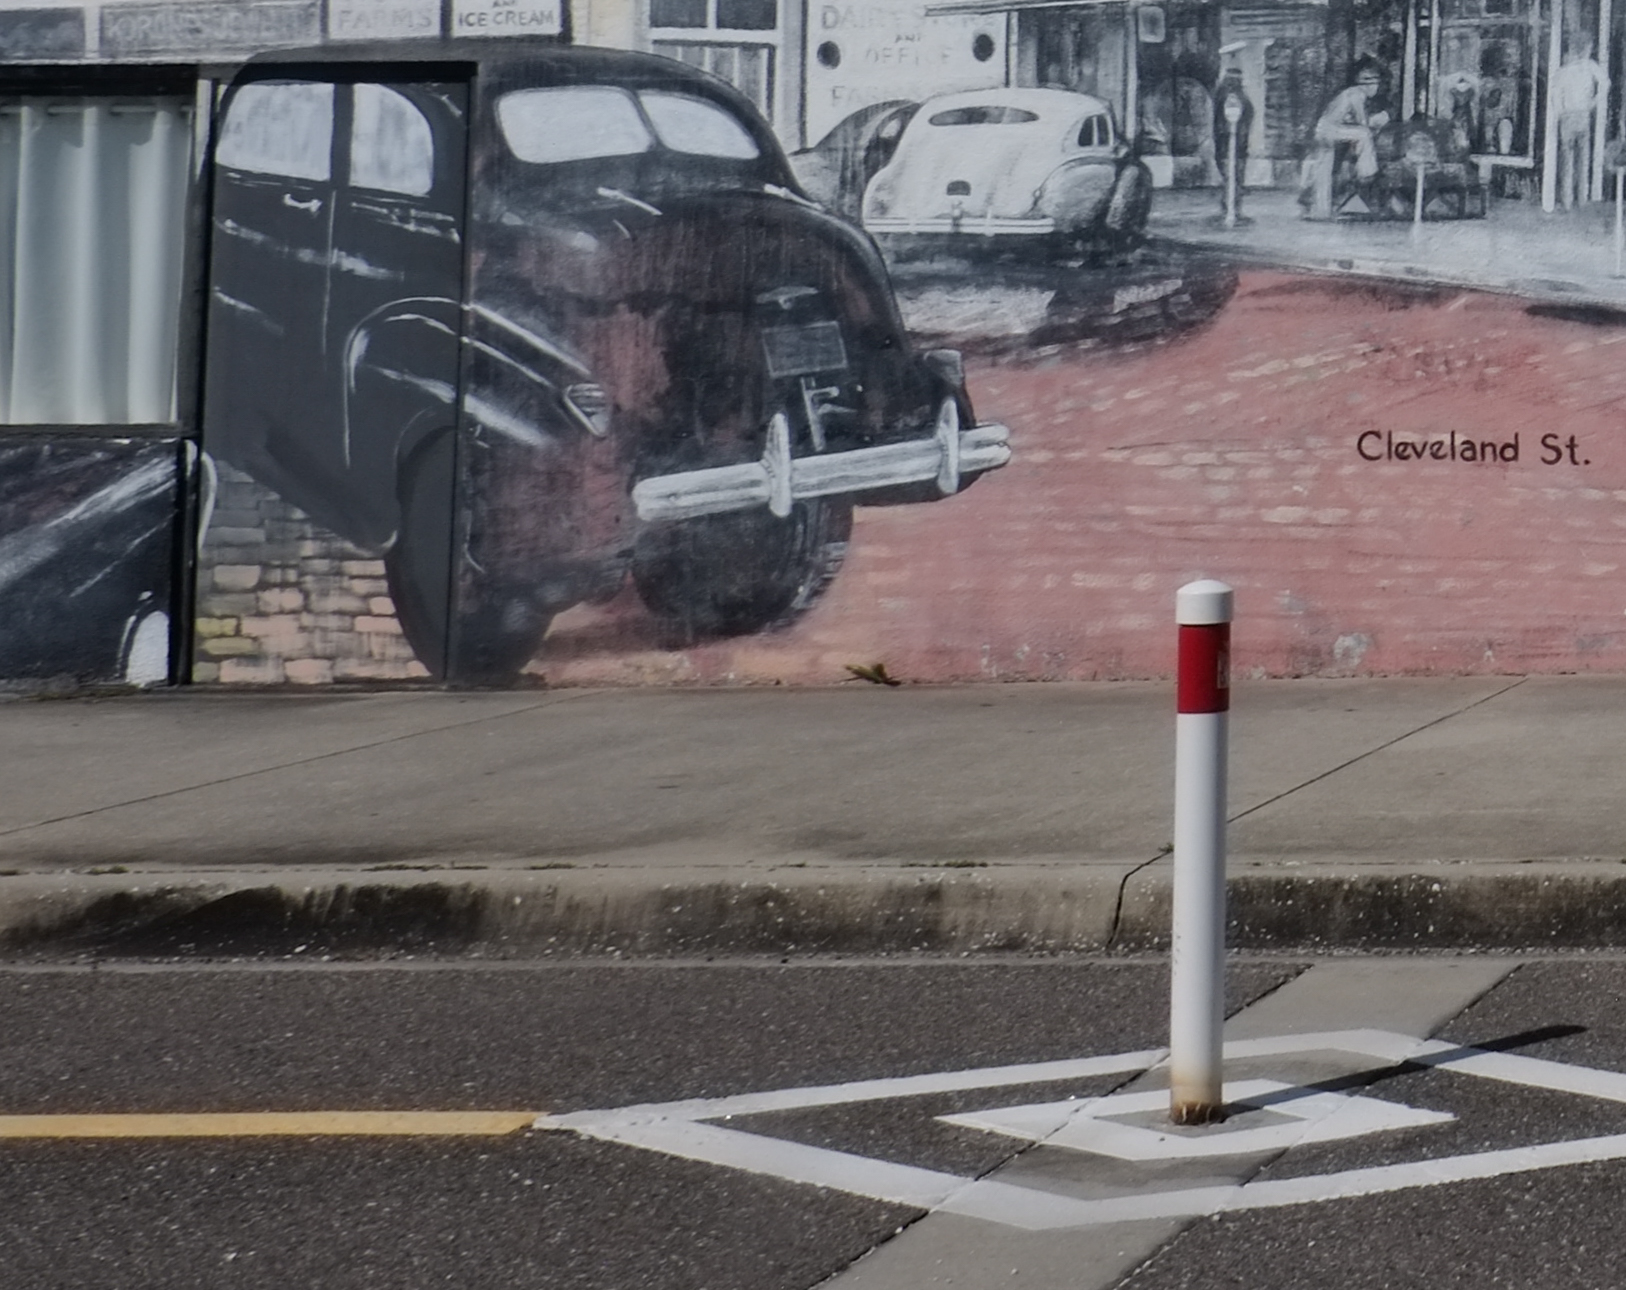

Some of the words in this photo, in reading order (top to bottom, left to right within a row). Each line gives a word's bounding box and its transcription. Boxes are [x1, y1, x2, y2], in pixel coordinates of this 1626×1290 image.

[458, 12, 488, 27] ICE
[493, 10, 555, 26] CREAM
[1357, 430, 1519, 462] Cleveland
[1540, 433, 1592, 466] St.
